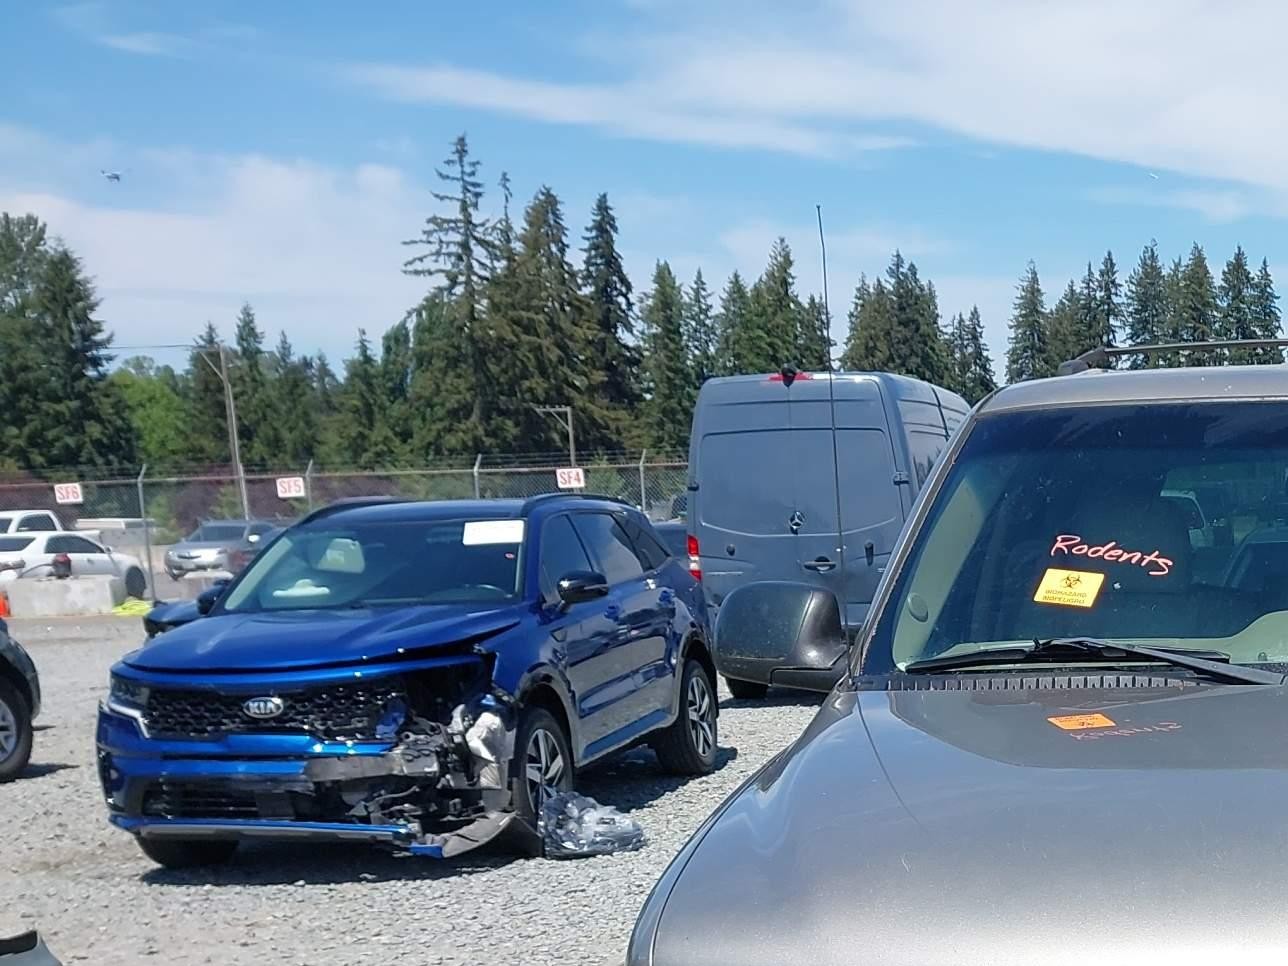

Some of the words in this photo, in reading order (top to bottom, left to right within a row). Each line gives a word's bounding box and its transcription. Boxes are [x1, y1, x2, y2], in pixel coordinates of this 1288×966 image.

[559, 470, 582, 486] SF4
[56, 485, 80, 501] SF6
[279, 479, 303, 495] SF5
[1050, 534, 1173, 576] Rodents
[248, 701, 278, 714] KIA
